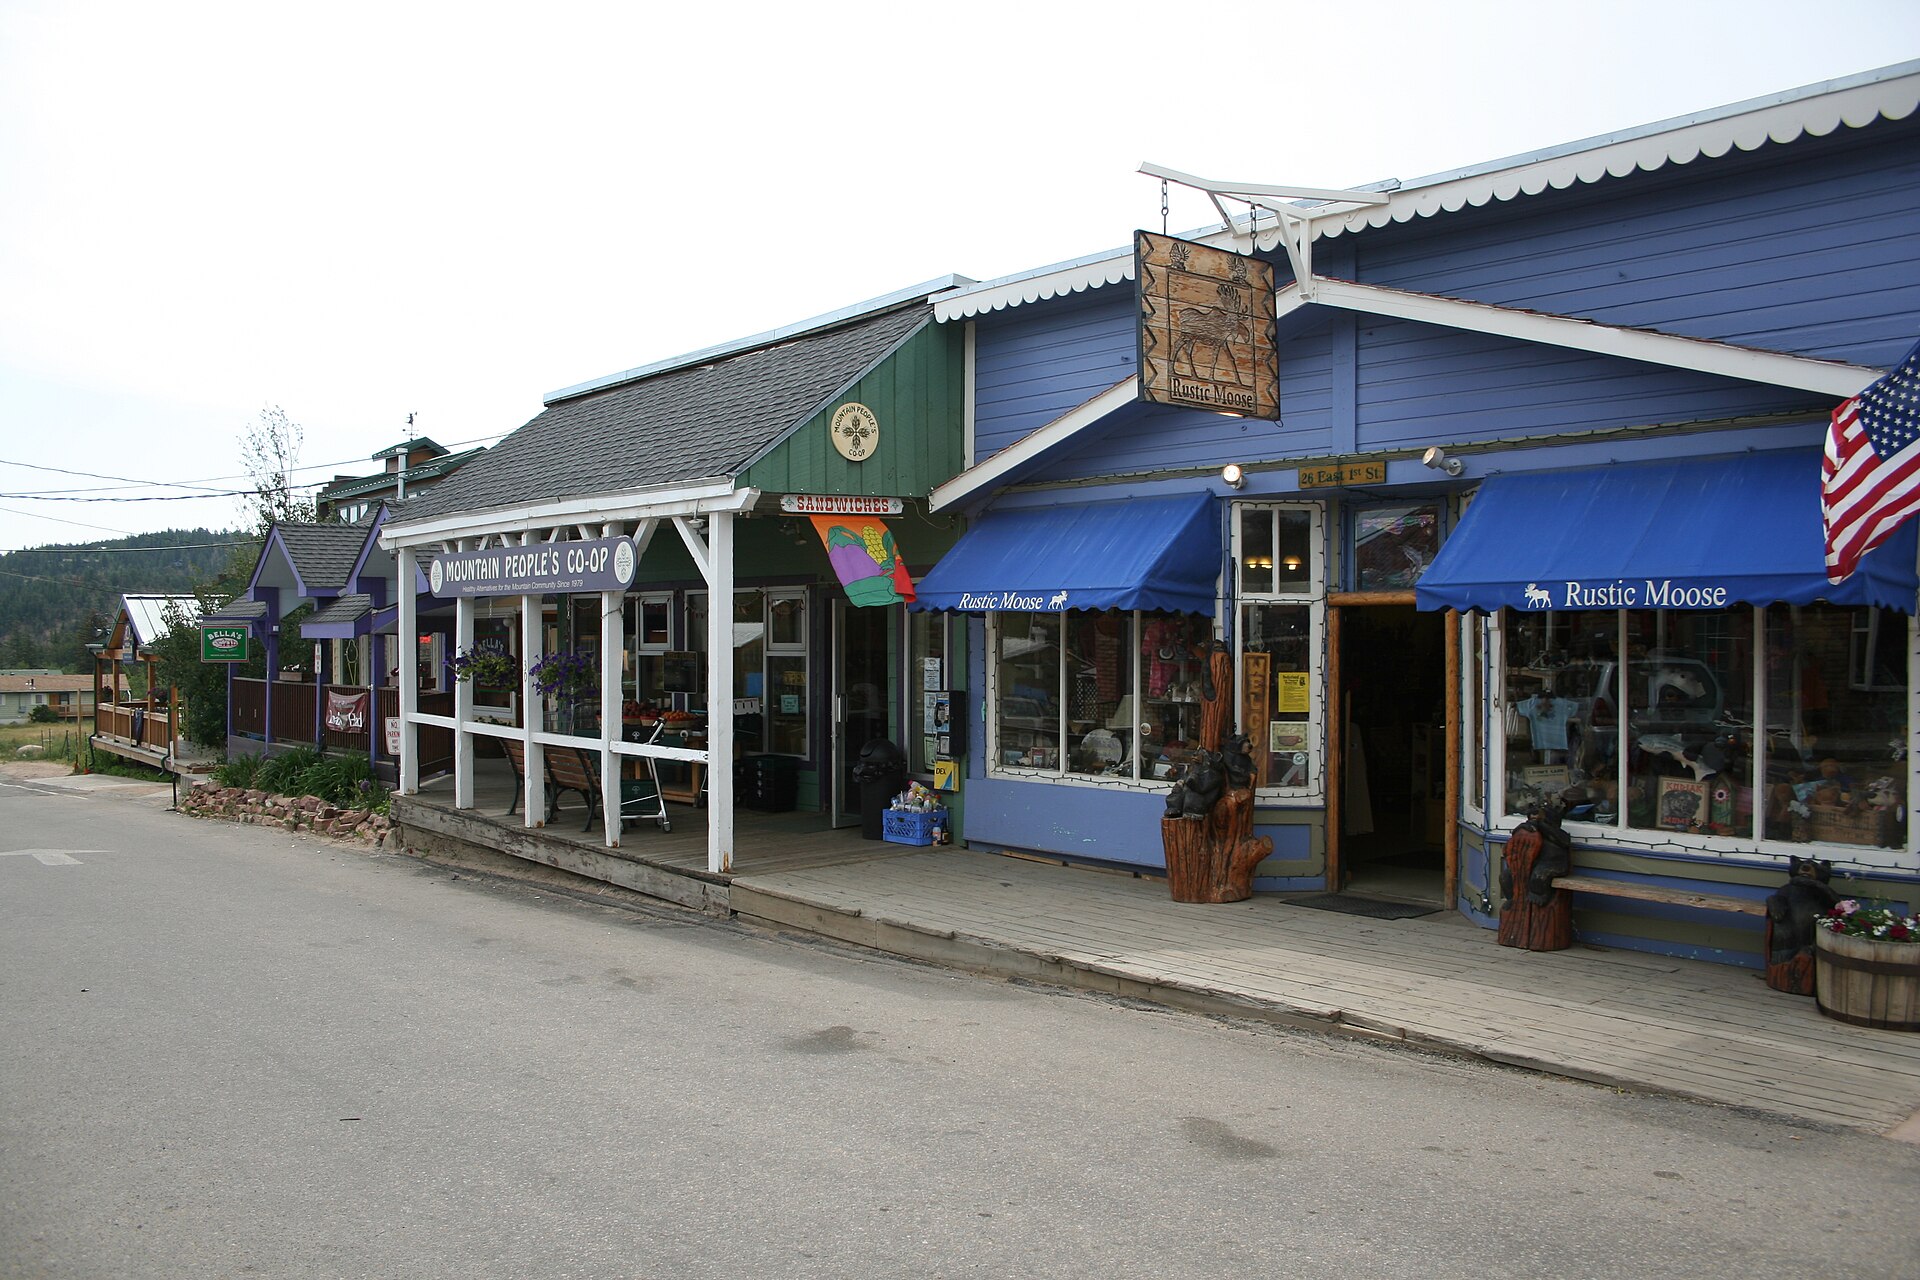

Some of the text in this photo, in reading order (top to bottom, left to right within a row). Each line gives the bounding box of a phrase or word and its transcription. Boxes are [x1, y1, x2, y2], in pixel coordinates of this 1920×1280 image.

[1172, 378, 1253, 408] Rustic Moose
[834, 405, 876, 433] MOUNTAIN PEOPLE'S
[1301, 472, 1314, 484] 26
[1318, 469, 1344, 483] East
[1349, 467, 1361, 480] 1st
[796, 496, 889, 512] SANDWICHES
[446, 547, 609, 582] MOUNTAIN PEOPLE'S CO-OP
[512, 582, 531, 591] Mountain
[532, 581, 556, 590] Community
[557, 580, 570, 588] Since
[571, 579, 584, 587] 1979
[1564, 580, 1727, 607] Rustic Moose
[959, 592, 1043, 610] Rustic Moose
[207, 630, 243, 640] BELLA'S
[480, 637, 505, 652] ELLA'S
[1247, 657, 1266, 748] WELCO
[387, 730, 400, 738] PARKIN
[1665, 782, 1704, 793] KODIAK
